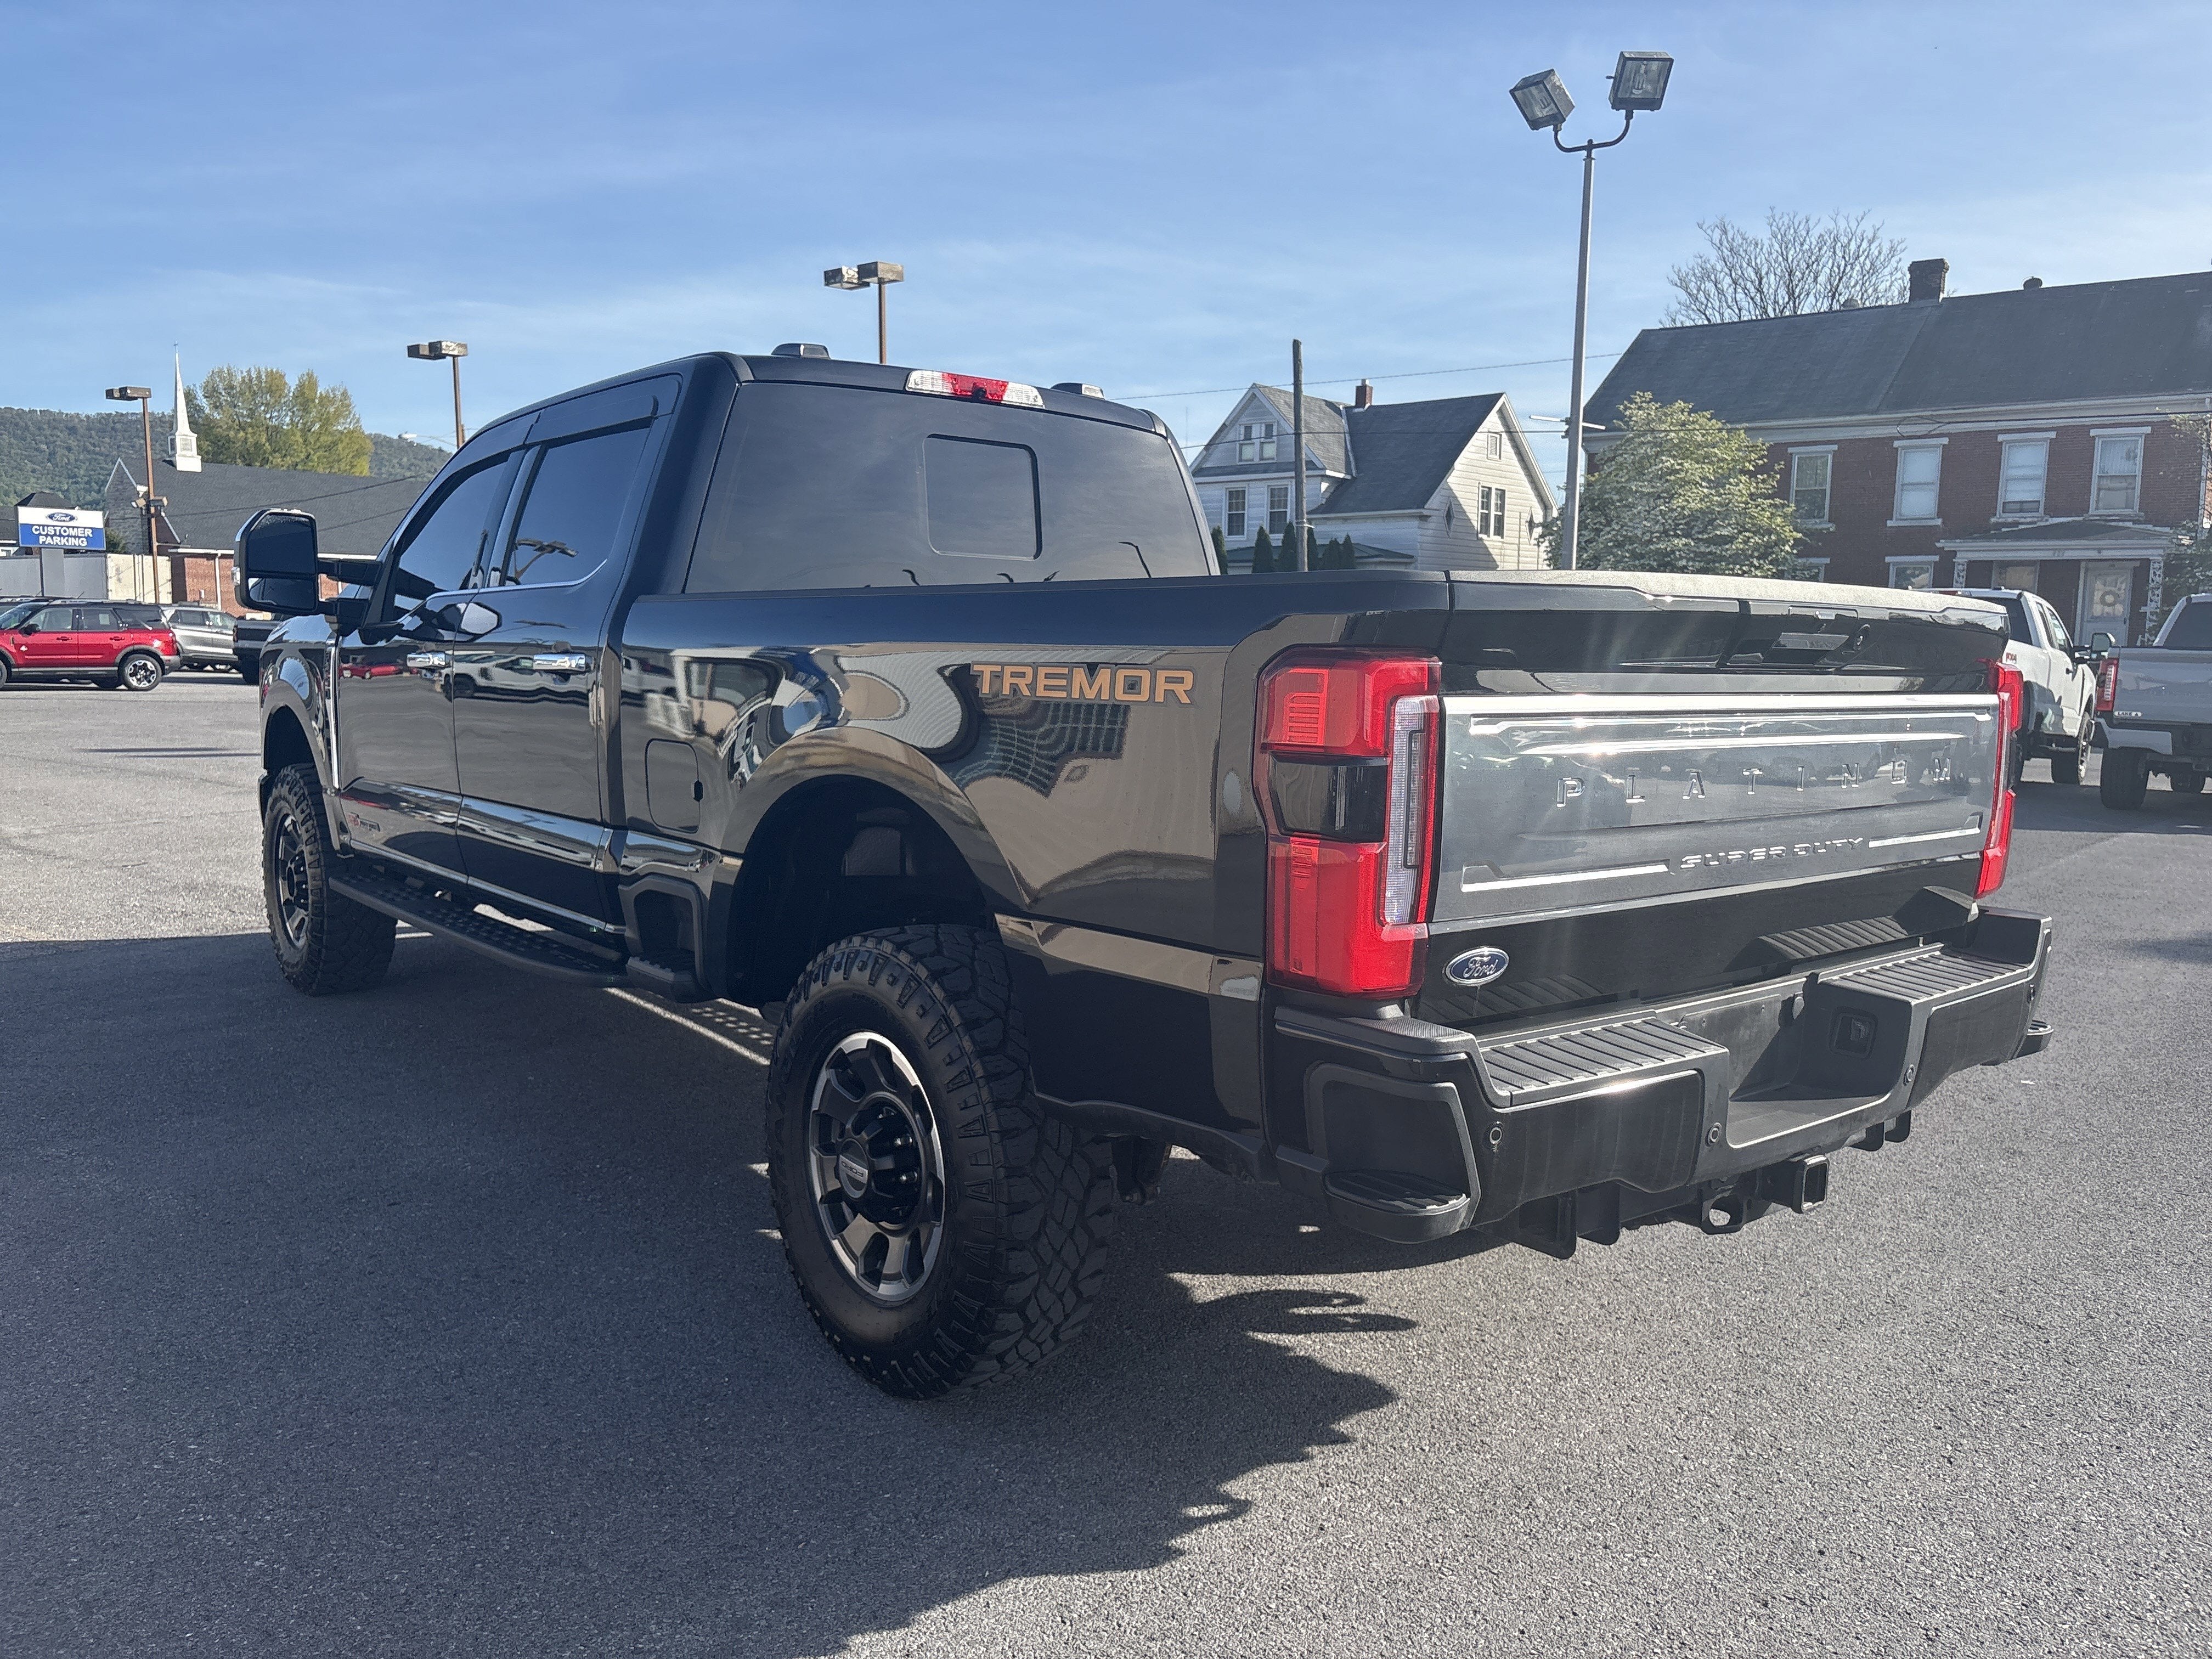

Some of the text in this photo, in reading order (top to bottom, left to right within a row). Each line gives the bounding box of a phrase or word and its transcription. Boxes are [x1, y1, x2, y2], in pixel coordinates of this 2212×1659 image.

[52, 513, 71, 521] Ford
[32, 525, 93, 537] CUSTOMER
[39, 535, 87, 546] PARKING
[972, 663, 1194, 705] TREMOR
[1556, 758, 1951, 807] PLATINUM
[1680, 837, 1863, 869] SUPER DUTY
[1463, 956, 1499, 978] Ford
[841, 1160, 864, 1178] FORD
